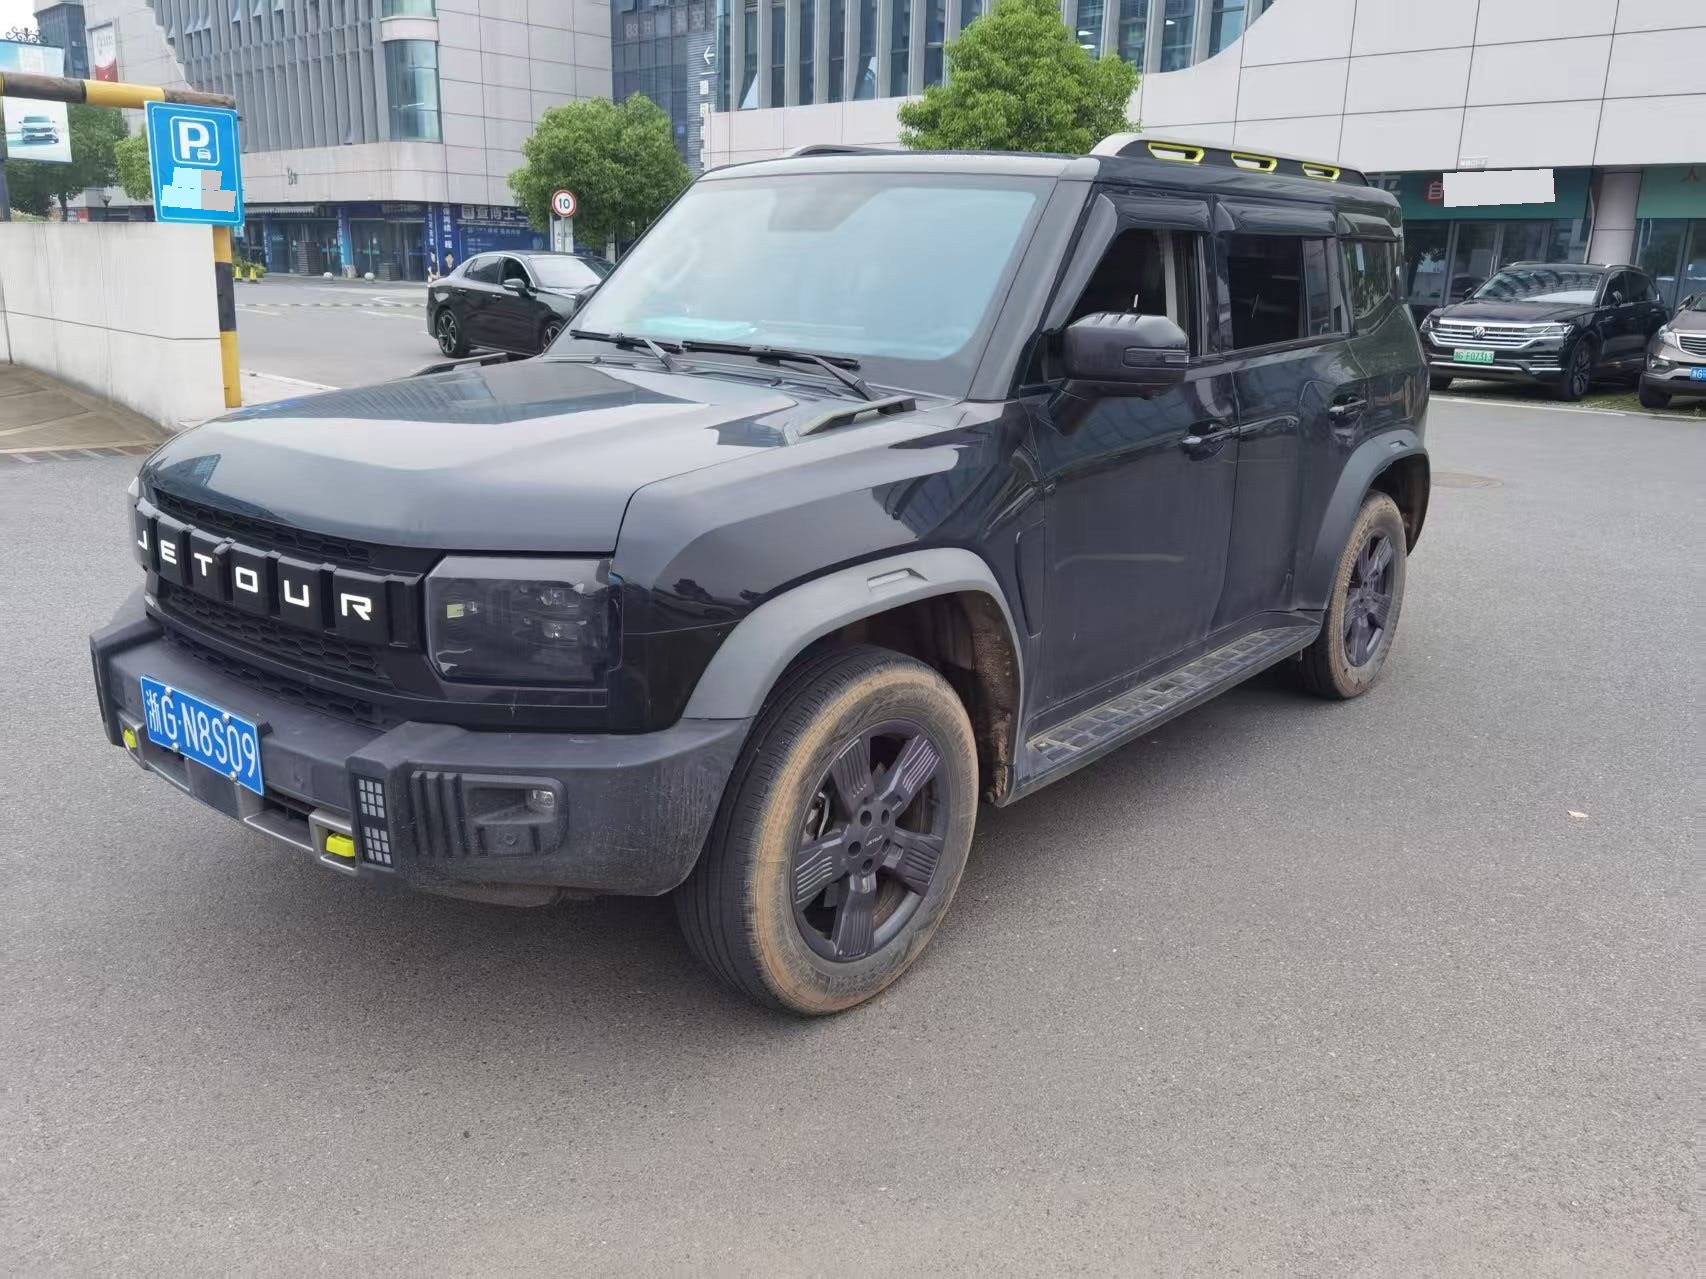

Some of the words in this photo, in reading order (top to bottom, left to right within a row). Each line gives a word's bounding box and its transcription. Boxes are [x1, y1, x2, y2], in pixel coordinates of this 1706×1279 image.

[178, 121, 210, 160] P
[559, 198, 570, 209] 10
[137, 530, 373, 622] JETOUR
